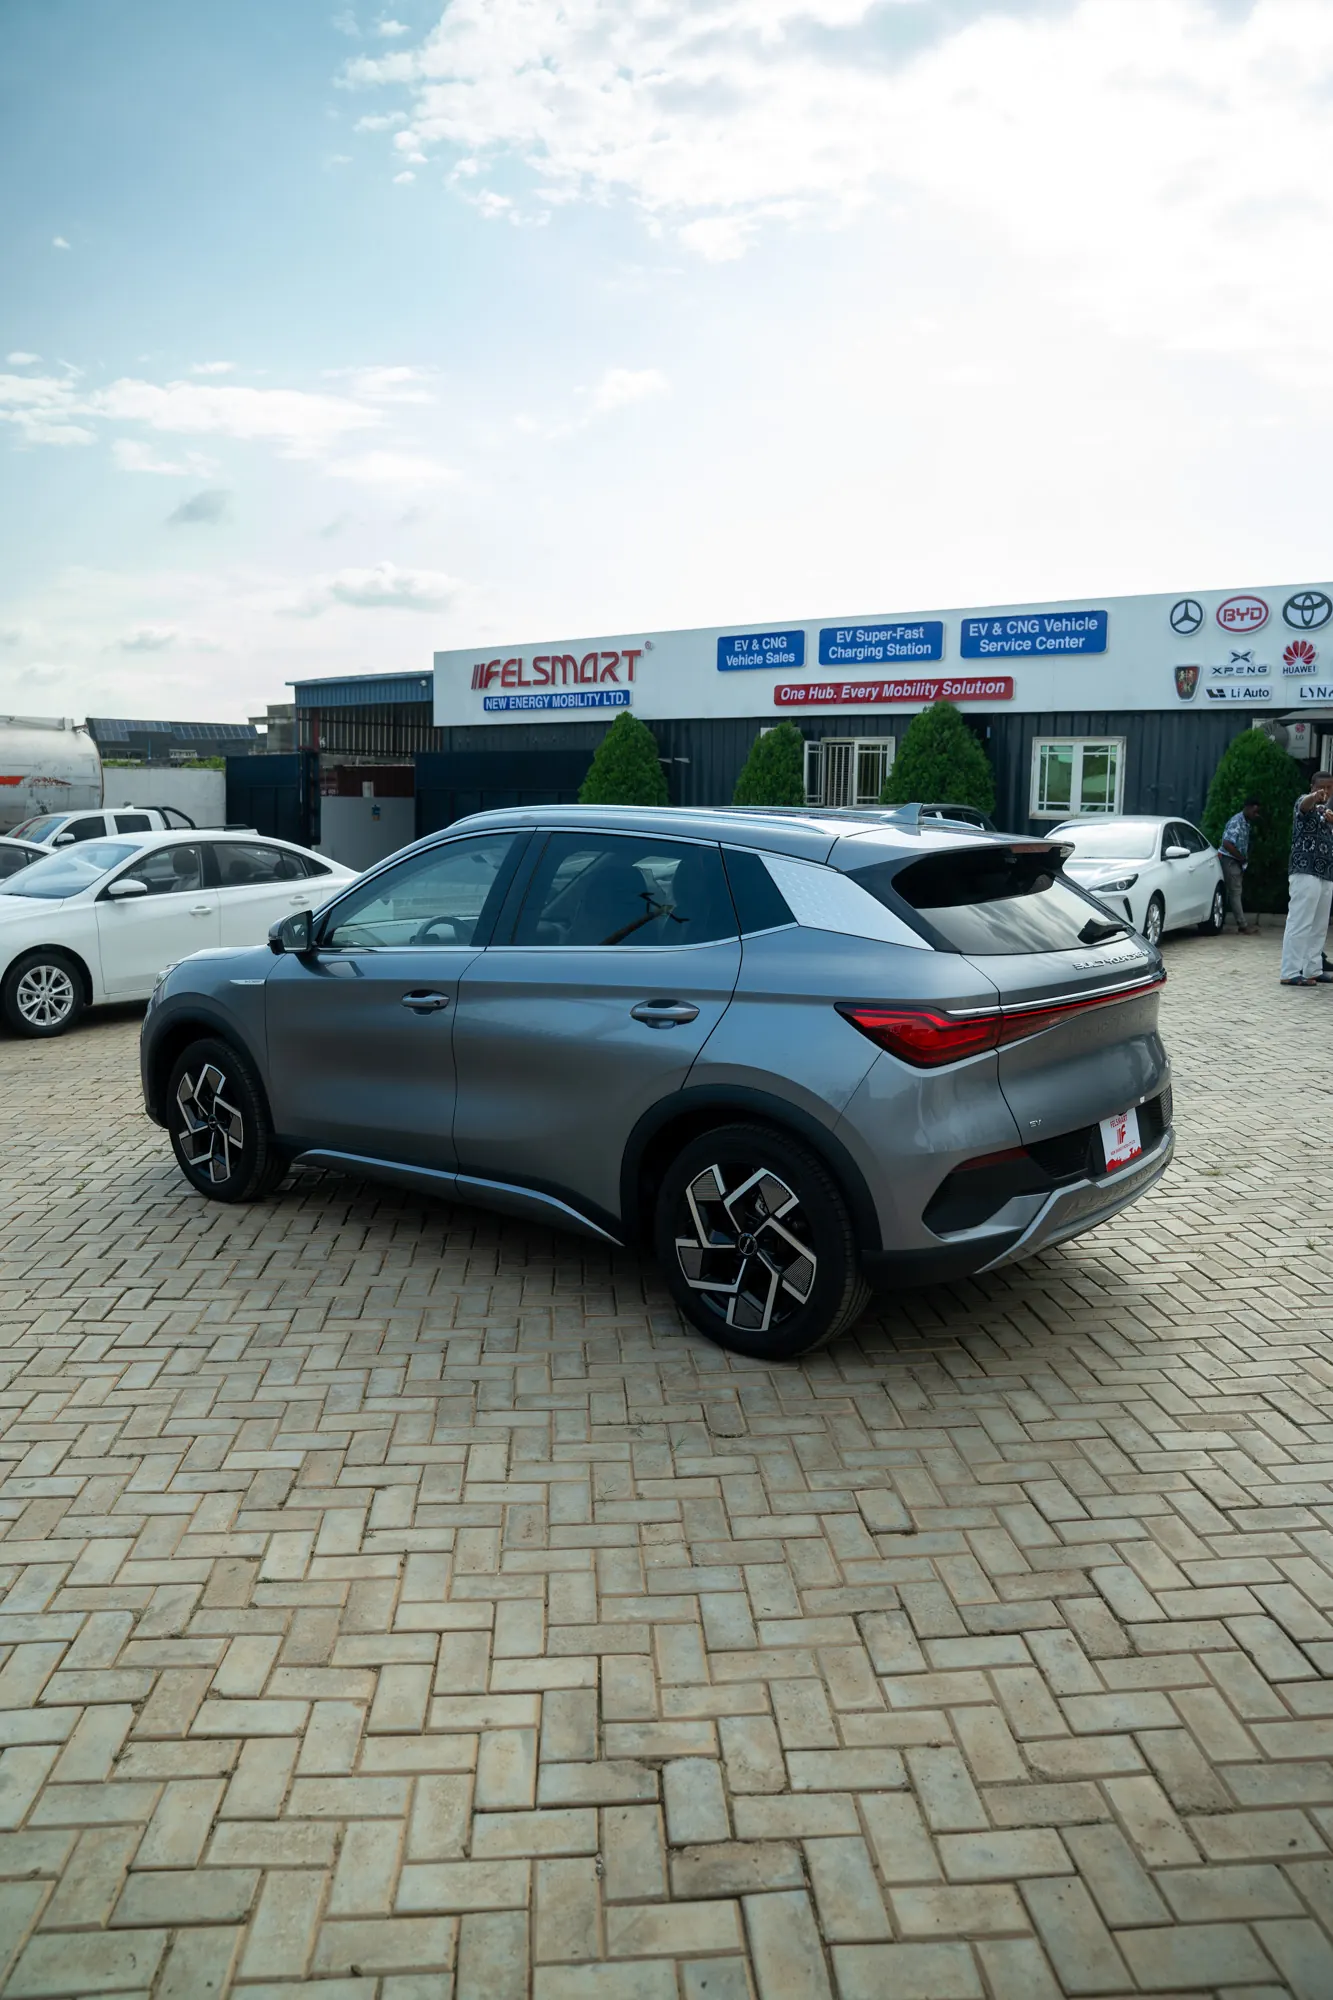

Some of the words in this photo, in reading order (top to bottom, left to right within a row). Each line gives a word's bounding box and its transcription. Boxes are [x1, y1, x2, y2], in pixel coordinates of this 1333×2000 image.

[1223, 607, 1263, 622] BYD
[969, 623, 989, 637] EV
[992, 623, 1003, 635] &
[1006, 620, 1040, 634] CNG
[1044, 616, 1098, 633] Vehicle
[734, 640, 749, 651] EV
[752, 639, 760, 650] &
[762, 636, 787, 649] CNG
[836, 631, 853, 643] EV
[856, 626, 924, 645] Super-Fast
[828, 644, 883, 660] Charging
[886, 642, 932, 656] Station
[980, 638, 1032, 653] Service
[1035, 636, 1085, 650] Center
[726, 653, 763, 667] Vehicle
[765, 651, 796, 664] Sales
[471, 650, 642, 690] FELSMART
[1212, 665, 1268, 675] XPENG
[1282, 665, 1316, 675] HUAWEI
[780, 687, 806, 701] One
[808, 685, 837, 700] Hub.
[841, 684, 880, 701] Every
[882, 680, 938, 699] Mobility
[1231, 688, 1241, 698] Li
[1243, 688, 1270, 698] Auto
[486, 698, 508, 710] NEW
[509, 695, 551, 709] ENERGY
[552, 693, 601, 708] MOBILITY
[603, 691, 627, 705] LTD.
